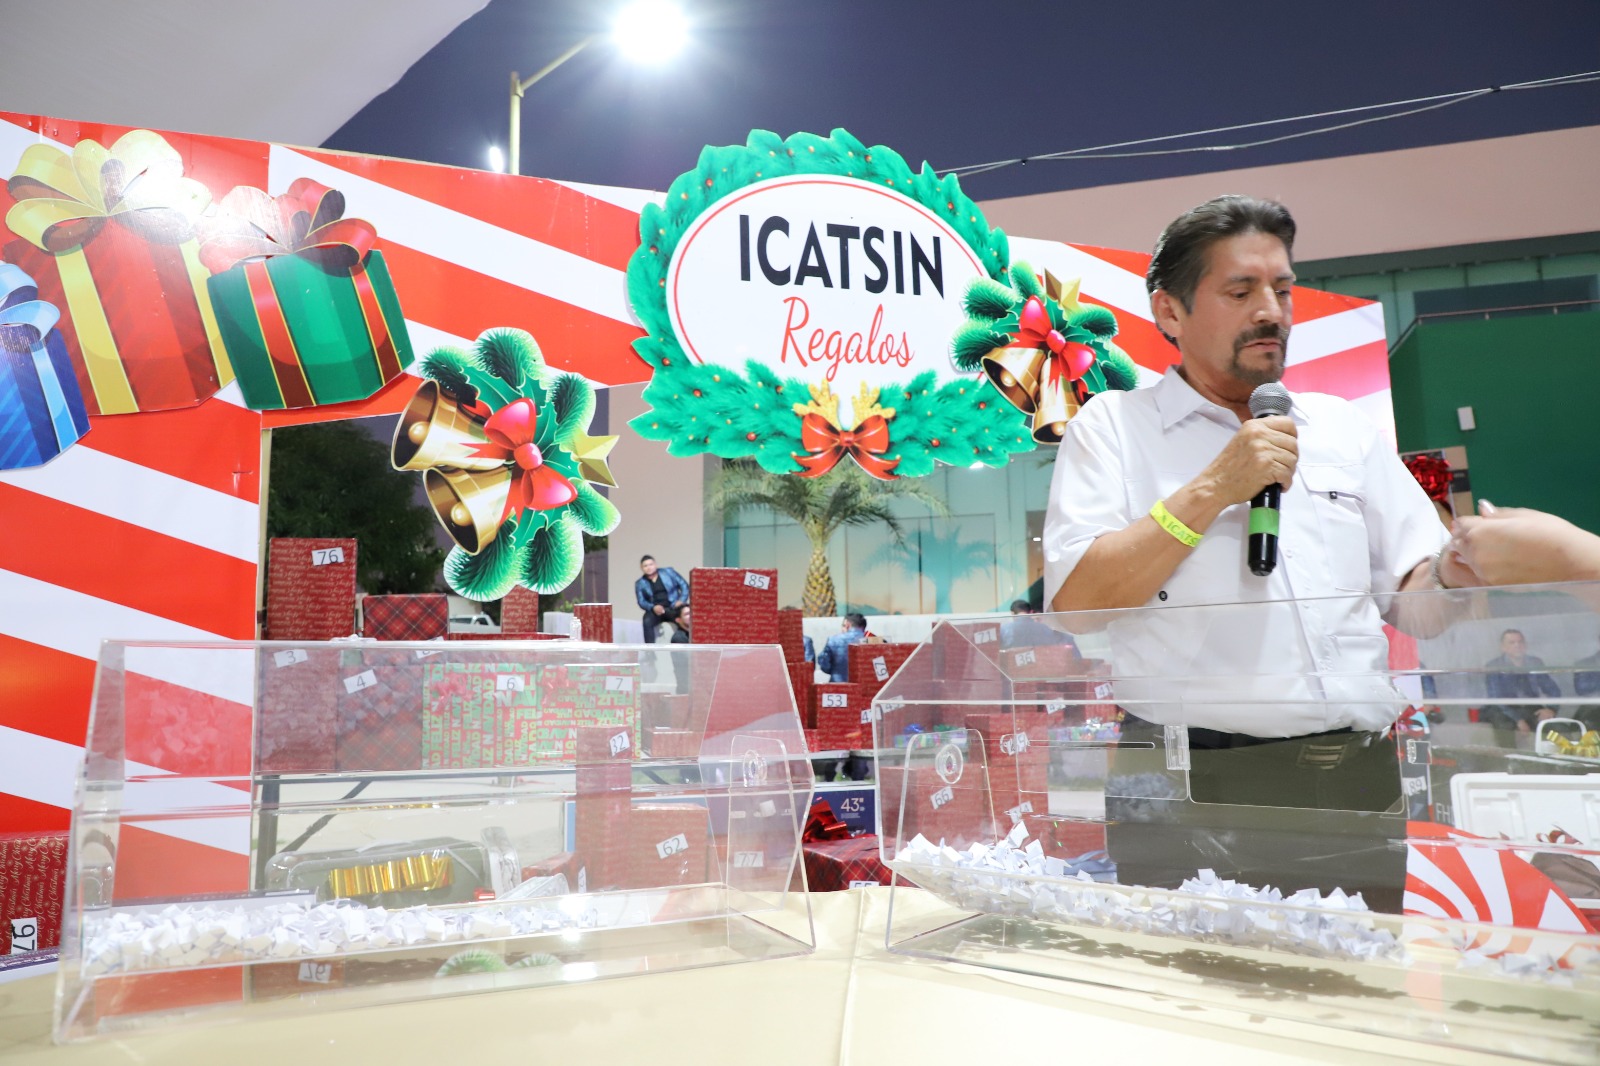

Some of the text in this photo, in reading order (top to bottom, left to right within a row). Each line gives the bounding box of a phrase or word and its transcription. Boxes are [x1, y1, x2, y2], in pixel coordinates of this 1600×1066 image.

[739, 214, 944, 300] ICATSIN
[781, 296, 915, 382] Regalos
[317, 549, 339, 565] 76
[748, 574, 765, 588] 85
[286, 650, 296, 664] 3
[357, 675, 366, 688] 4
[507, 677, 515, 691] 6
[615, 677, 624, 690] 7
[827, 694, 843, 707] 53
[483, 678, 494, 745] NAVIDAD
[611, 734, 627, 754] 32
[935, 789, 950, 806] 66
[662, 837, 683, 857] 62
[740, 853, 758, 866] 77
[11, 923, 35, 951] 97
